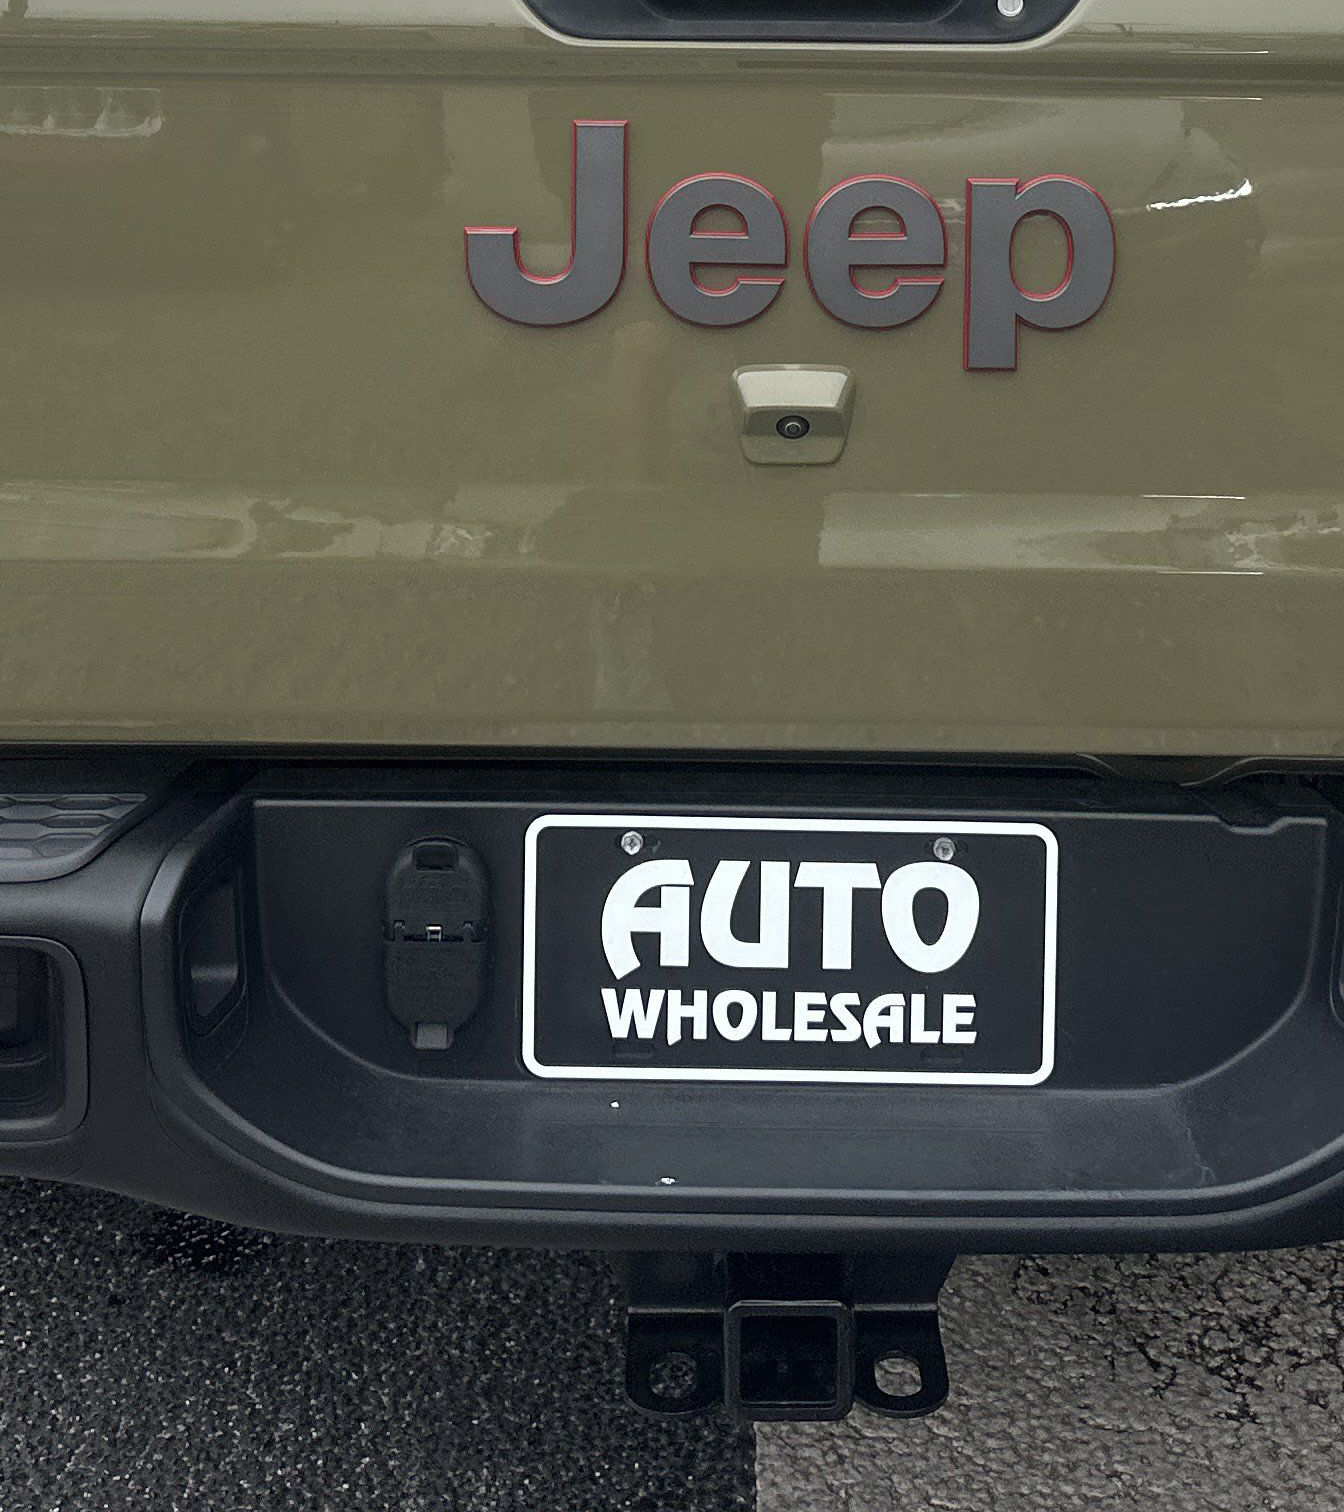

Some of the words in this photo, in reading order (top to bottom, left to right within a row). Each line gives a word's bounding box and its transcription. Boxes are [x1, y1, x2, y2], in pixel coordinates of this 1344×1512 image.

[464, 119, 1117, 371] Jeep
[600, 859, 981, 980] AUTO
[600, 987, 978, 1048] WHOLESALE
